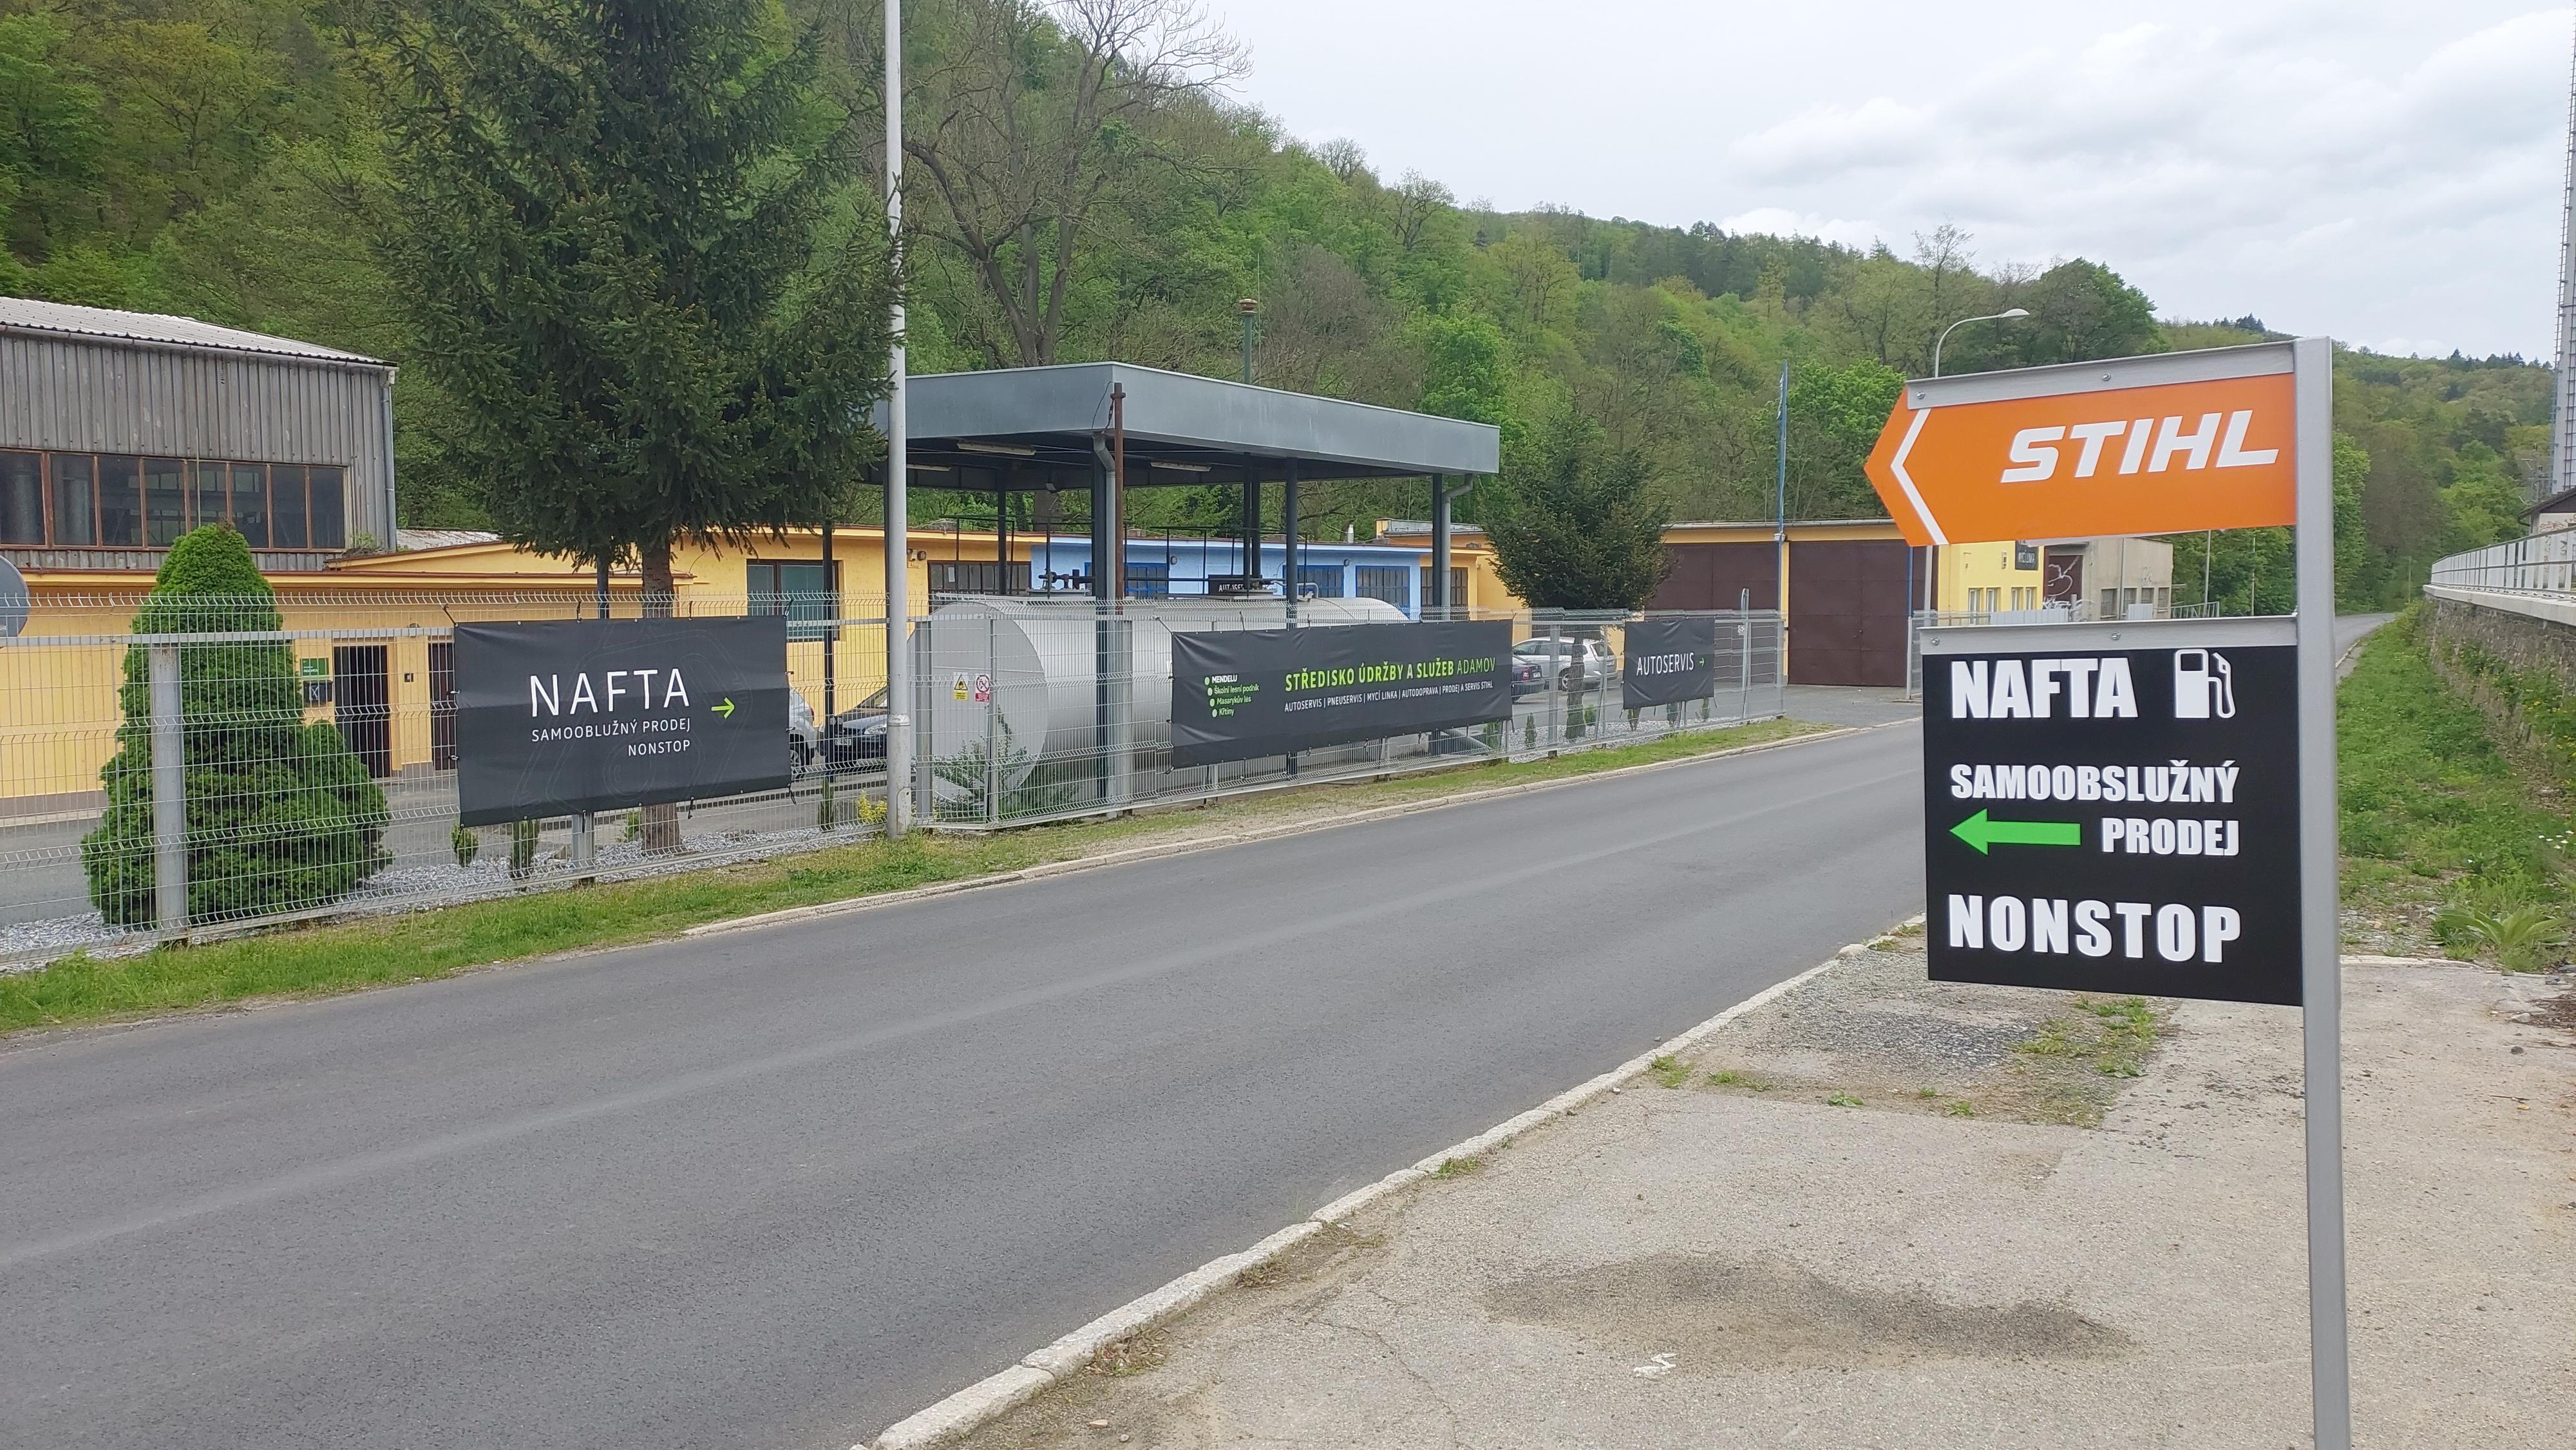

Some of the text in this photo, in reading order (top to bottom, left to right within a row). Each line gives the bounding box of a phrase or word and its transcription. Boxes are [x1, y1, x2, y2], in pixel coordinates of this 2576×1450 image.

[2001, 410, 2279, 483] STIHL
[1211, 674, 1238, 683] MENDELU
[1285, 657, 1495, 692] STŘEDISKO ÚDRŽBY A SLUŽEB ADAMOV
[1636, 652, 1694, 676] AUTOSERVIS
[530, 668, 690, 717] NAFTA
[1214, 685, 1230, 694] Školní
[1284, 679, 1494, 713] AUTOSERVIS PNEUSERVIS MYCÍ LINKA AUTODOPRAVA PRODEJ A SERVIS STIHL
[1951, 657, 2138, 719] NAFTA
[532, 717, 690, 742] SAMOOBLUŽNÝ PRODEJ
[629, 740, 690, 757] NONSTOP
[1951, 760, 2240, 803] SAMOOBSLUŽNÝ
[2102, 818, 2239, 856] PRODEJ
[1949, 894, 2240, 963] NONSTOP
